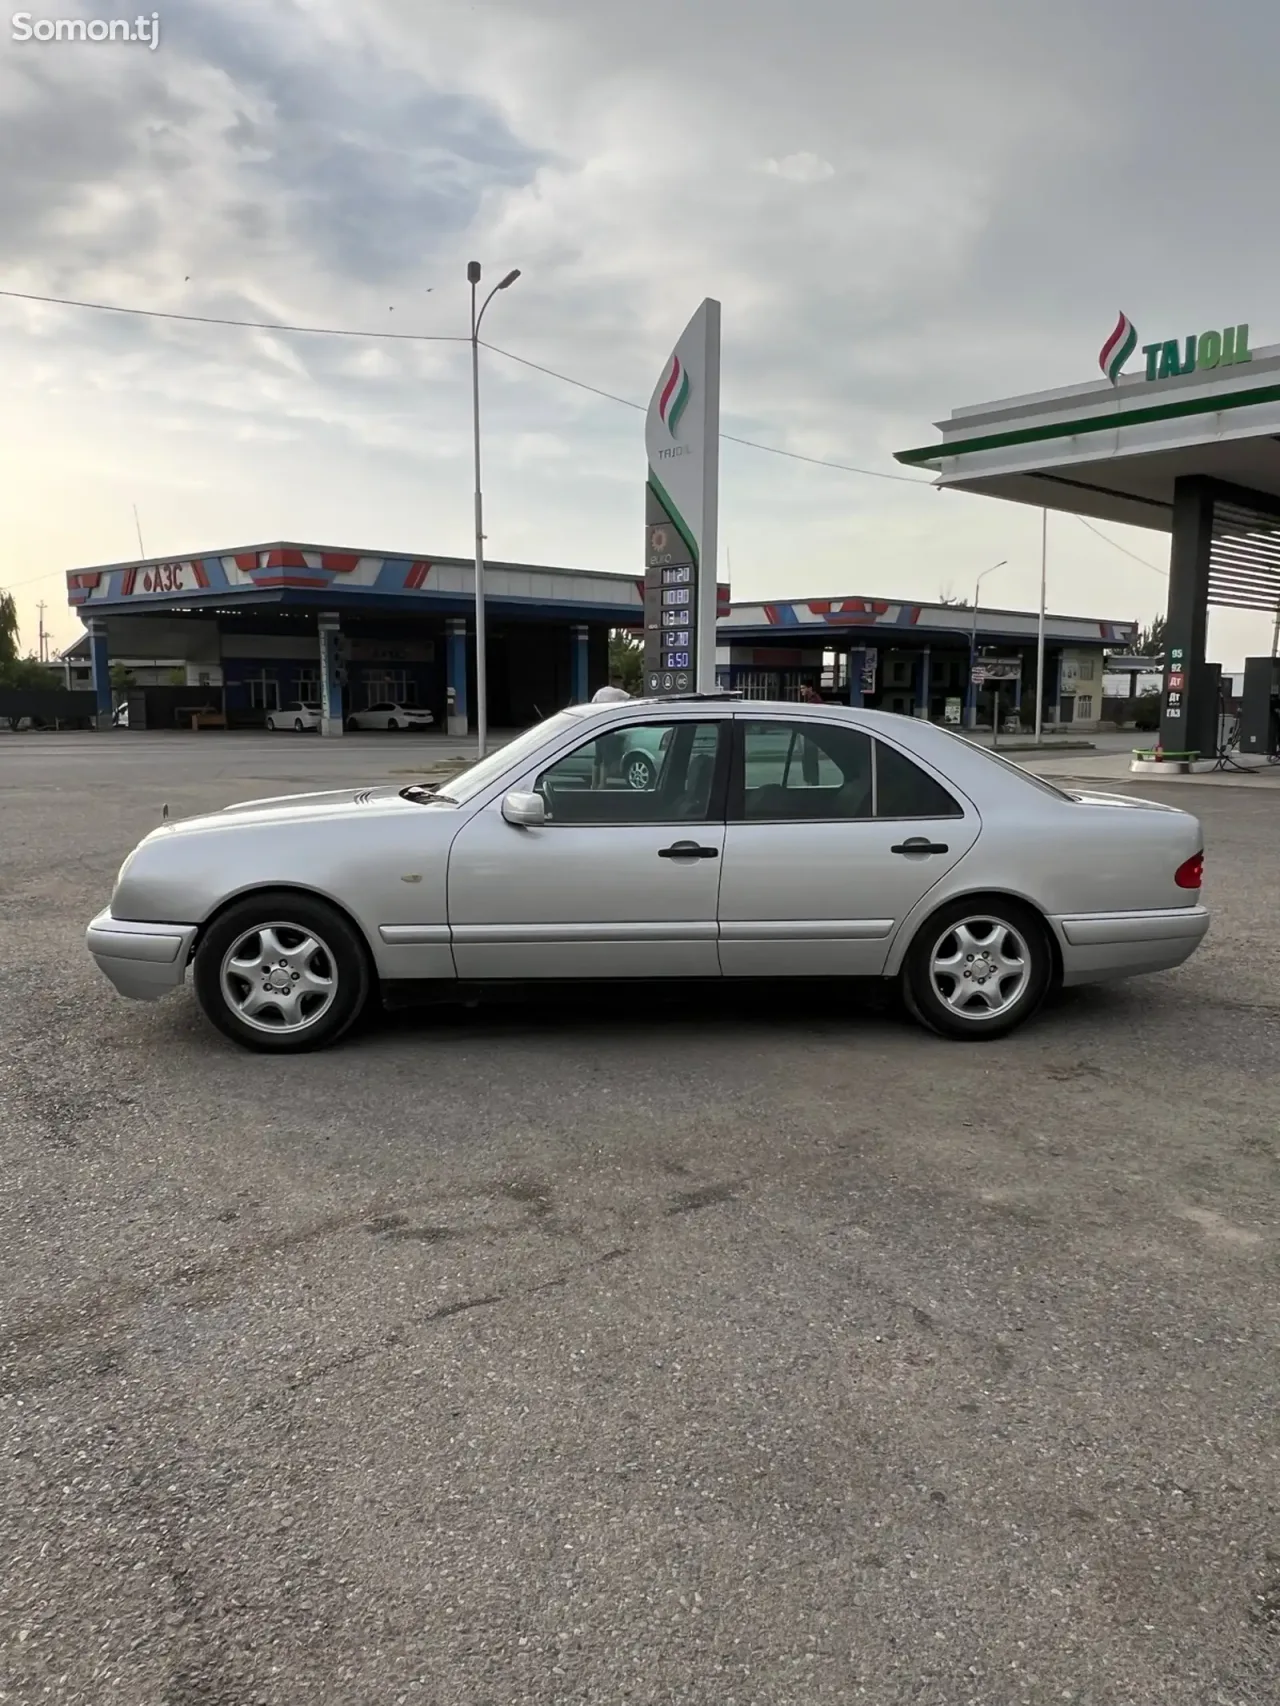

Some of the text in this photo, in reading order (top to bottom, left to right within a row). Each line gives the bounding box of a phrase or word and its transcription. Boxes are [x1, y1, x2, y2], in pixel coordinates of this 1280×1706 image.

[1142, 323, 1252, 381] TAJOIL
[153, 563, 183, 592] АЗС
[1171, 649, 1183, 658] 95
[1171, 663, 1182, 672] 92
[1166, 708, 1181, 718] ГАЗ
